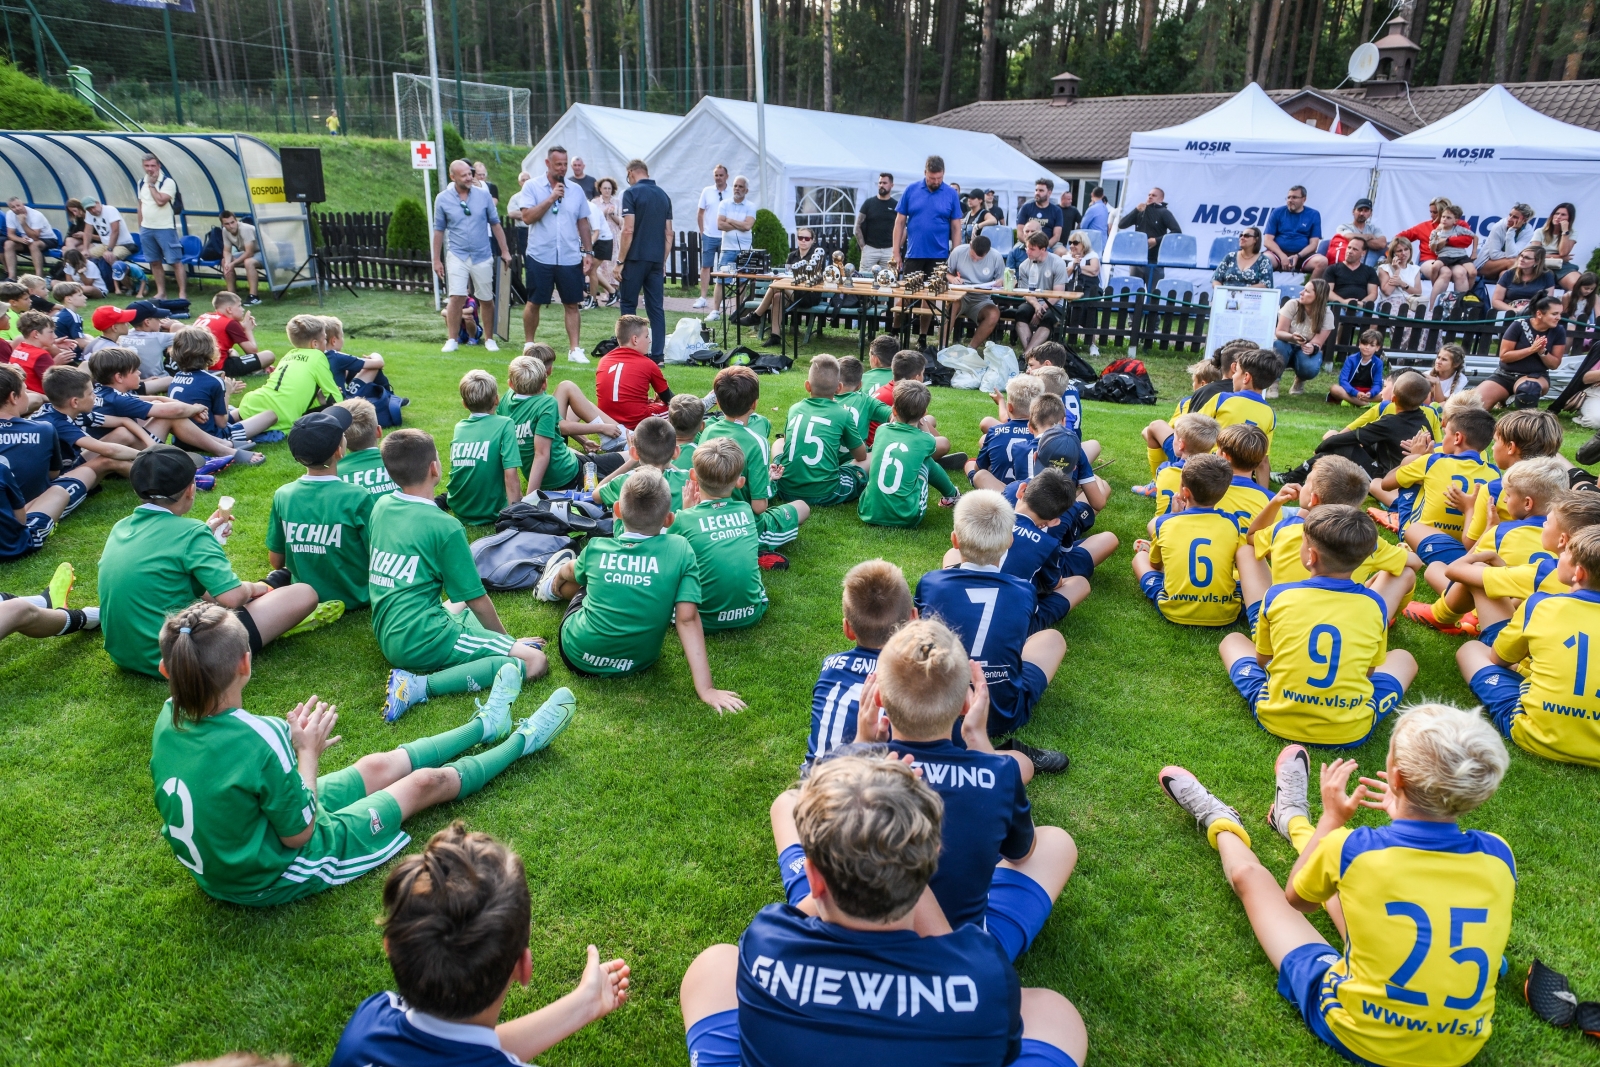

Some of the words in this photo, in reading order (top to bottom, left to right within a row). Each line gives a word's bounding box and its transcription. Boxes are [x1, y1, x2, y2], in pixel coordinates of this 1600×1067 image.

[1185, 141, 1231, 151] MOSIR
[1442, 148, 1495, 159] MOSIR
[251, 186, 285, 195] GOSPODA
[1191, 204, 1275, 227] MOSI
[608, 362, 624, 402] 1
[788, 413, 832, 466] 15
[876, 442, 909, 495] 6
[698, 511, 751, 533] LECHIA
[709, 527, 749, 541] CAMPS
[598, 552, 660, 575] LECHIA
[1188, 537, 1214, 589] 6
[603, 571, 652, 587] CAMPS
[1170, 593, 1233, 604] www.vls.pl
[717, 605, 755, 622] BORYS
[965, 587, 1000, 658] 7
[1306, 623, 1342, 689] 9
[1282, 687, 1364, 710] www.vls.pl
[1378, 691, 1398, 713] 6
[162, 776, 204, 876] 3
[1384, 900, 1490, 1011] 25
[750, 954, 979, 1018] GNIEWINO
